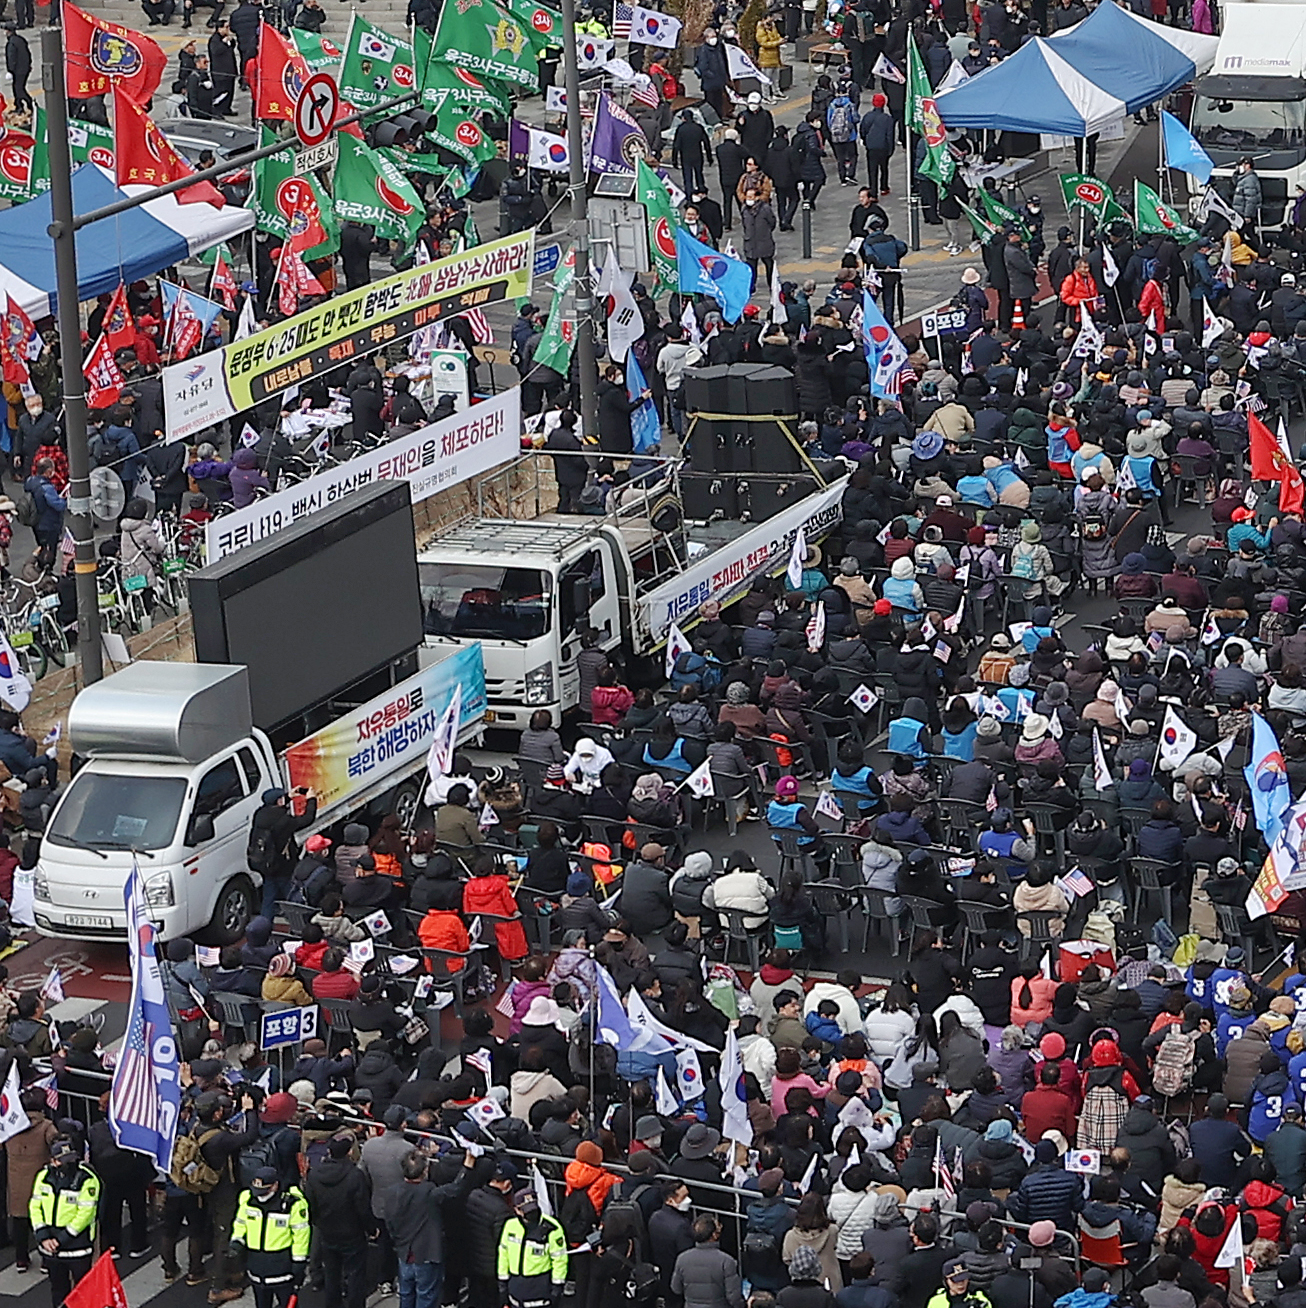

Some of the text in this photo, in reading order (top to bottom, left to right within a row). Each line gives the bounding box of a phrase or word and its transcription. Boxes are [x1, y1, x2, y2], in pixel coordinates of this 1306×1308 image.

[1244, 58, 1292, 67] mediamax
[296, 143, 336, 171] 적신호시
[363, 282, 404, 320] 함박도
[925, 312, 966, 333] 9 포항
[174, 377, 214, 403] 자유당
[439, 409, 505, 458] 체포하라!
[356, 686, 424, 744] 자유통일로
[346, 708, 438, 779] 북한 해방하자
[266, 1011, 315, 1038] 포항 3
[1265, 1095, 1283, 1119] 3
